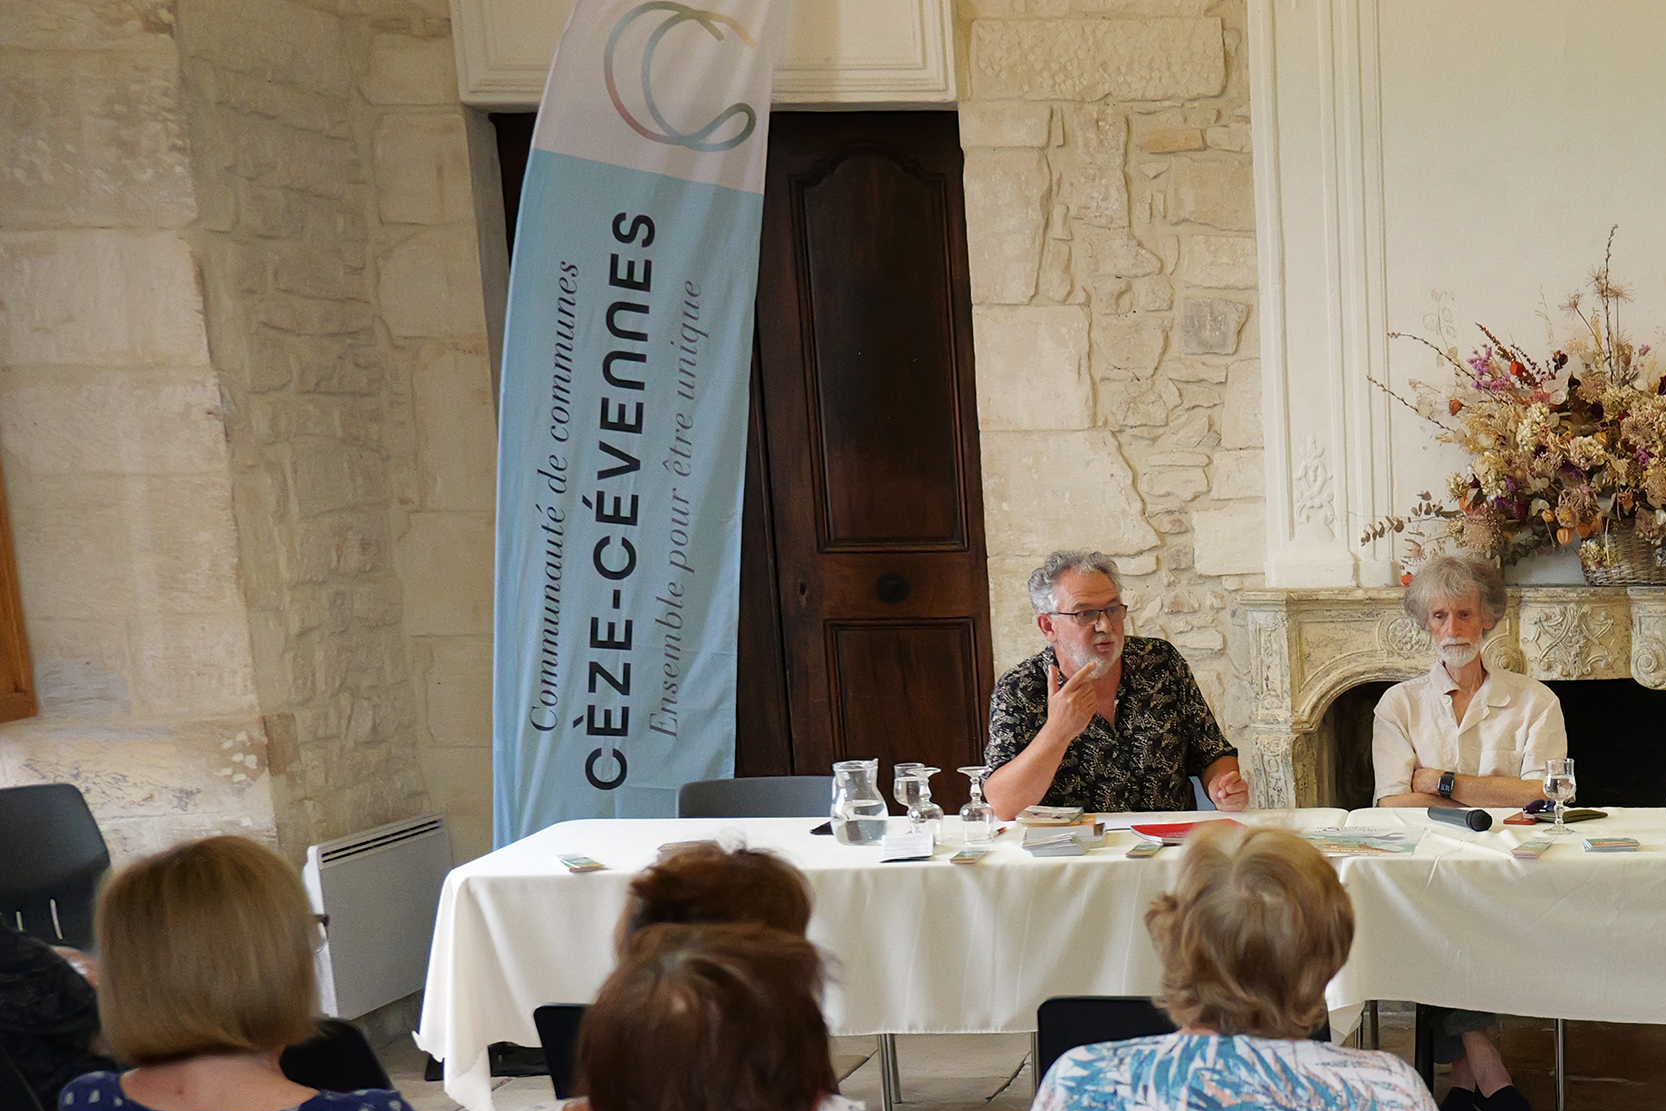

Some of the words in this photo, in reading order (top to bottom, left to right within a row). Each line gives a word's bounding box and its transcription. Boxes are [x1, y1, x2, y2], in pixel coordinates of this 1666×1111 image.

[550, 260, 579, 443] communes
[669, 280, 709, 401] unique
[537, 454, 568, 494] de
[662, 412, 694, 477] être
[668, 487, 695, 574] pour
[529, 504, 566, 732] Communauté
[650, 581, 685, 737] Ensemble
